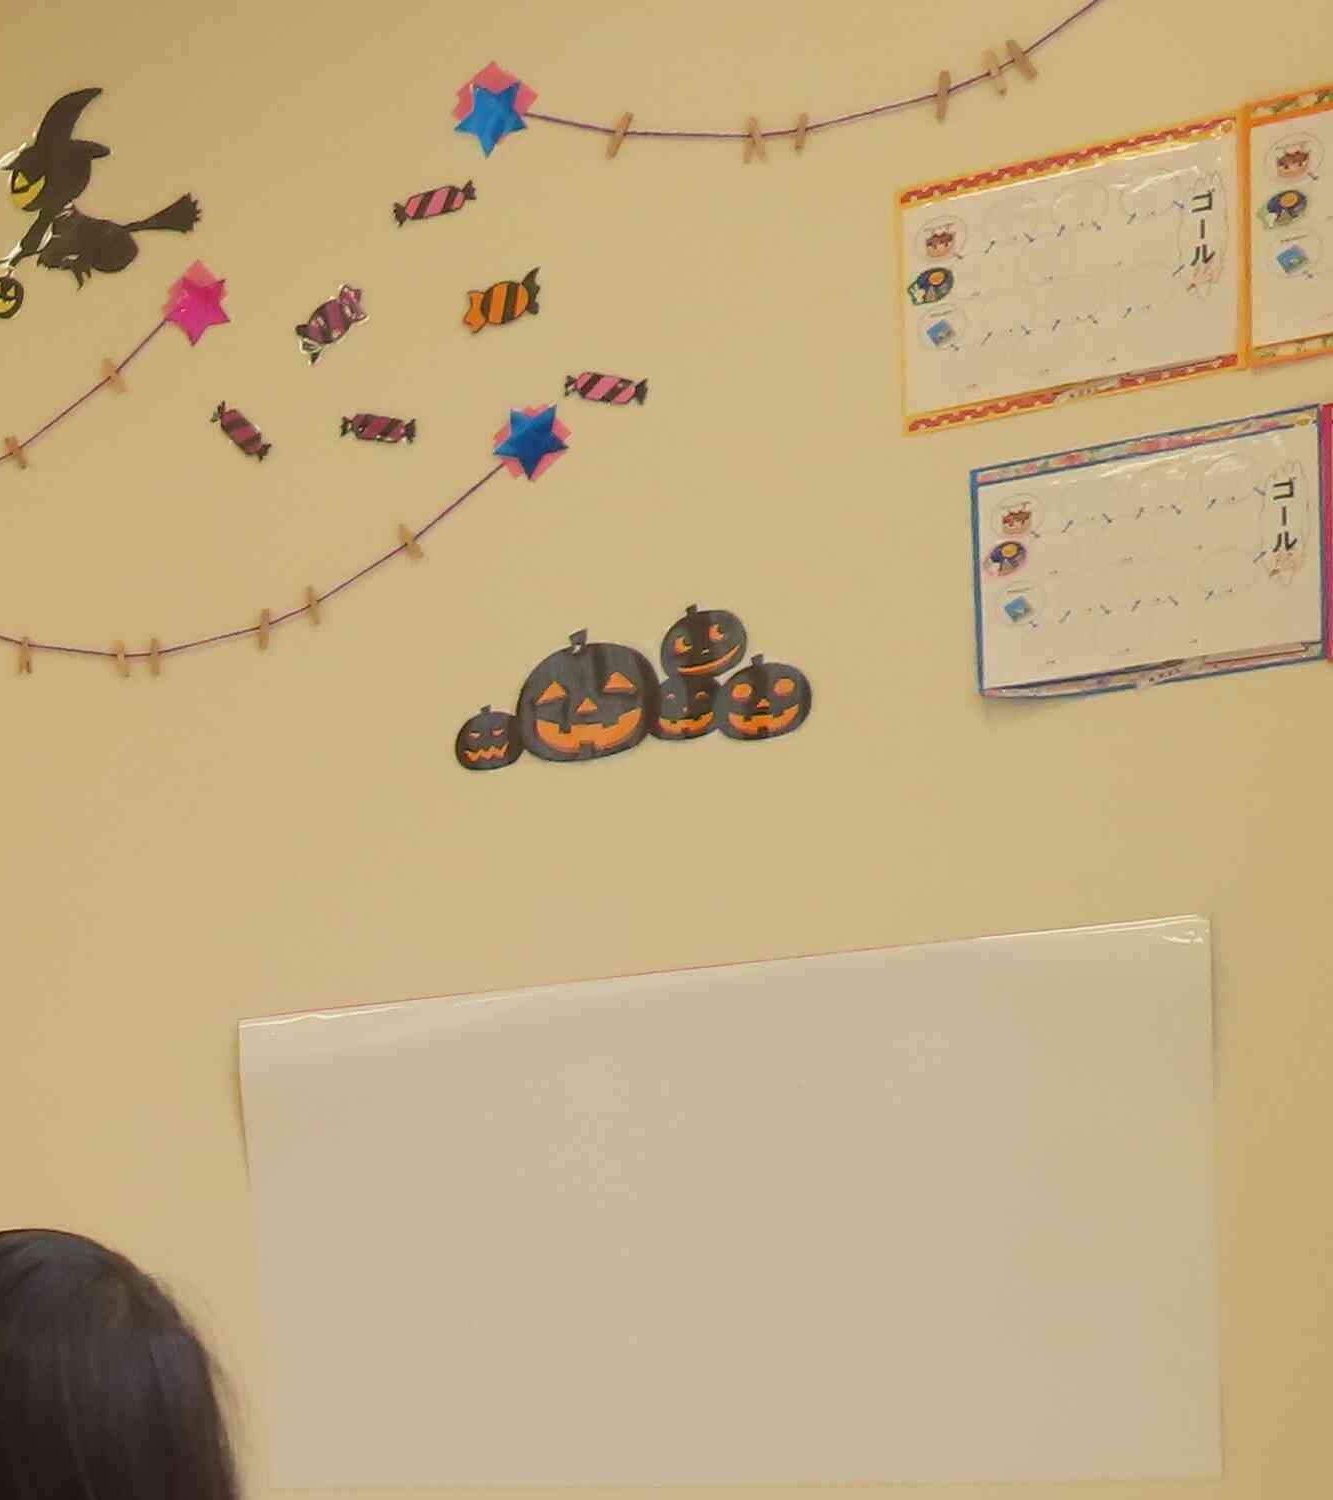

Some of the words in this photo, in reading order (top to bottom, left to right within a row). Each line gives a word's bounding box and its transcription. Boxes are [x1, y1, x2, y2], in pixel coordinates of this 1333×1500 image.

[1189, 187, 1216, 267] ゴール
[1271, 476, 1299, 553] ゴール
